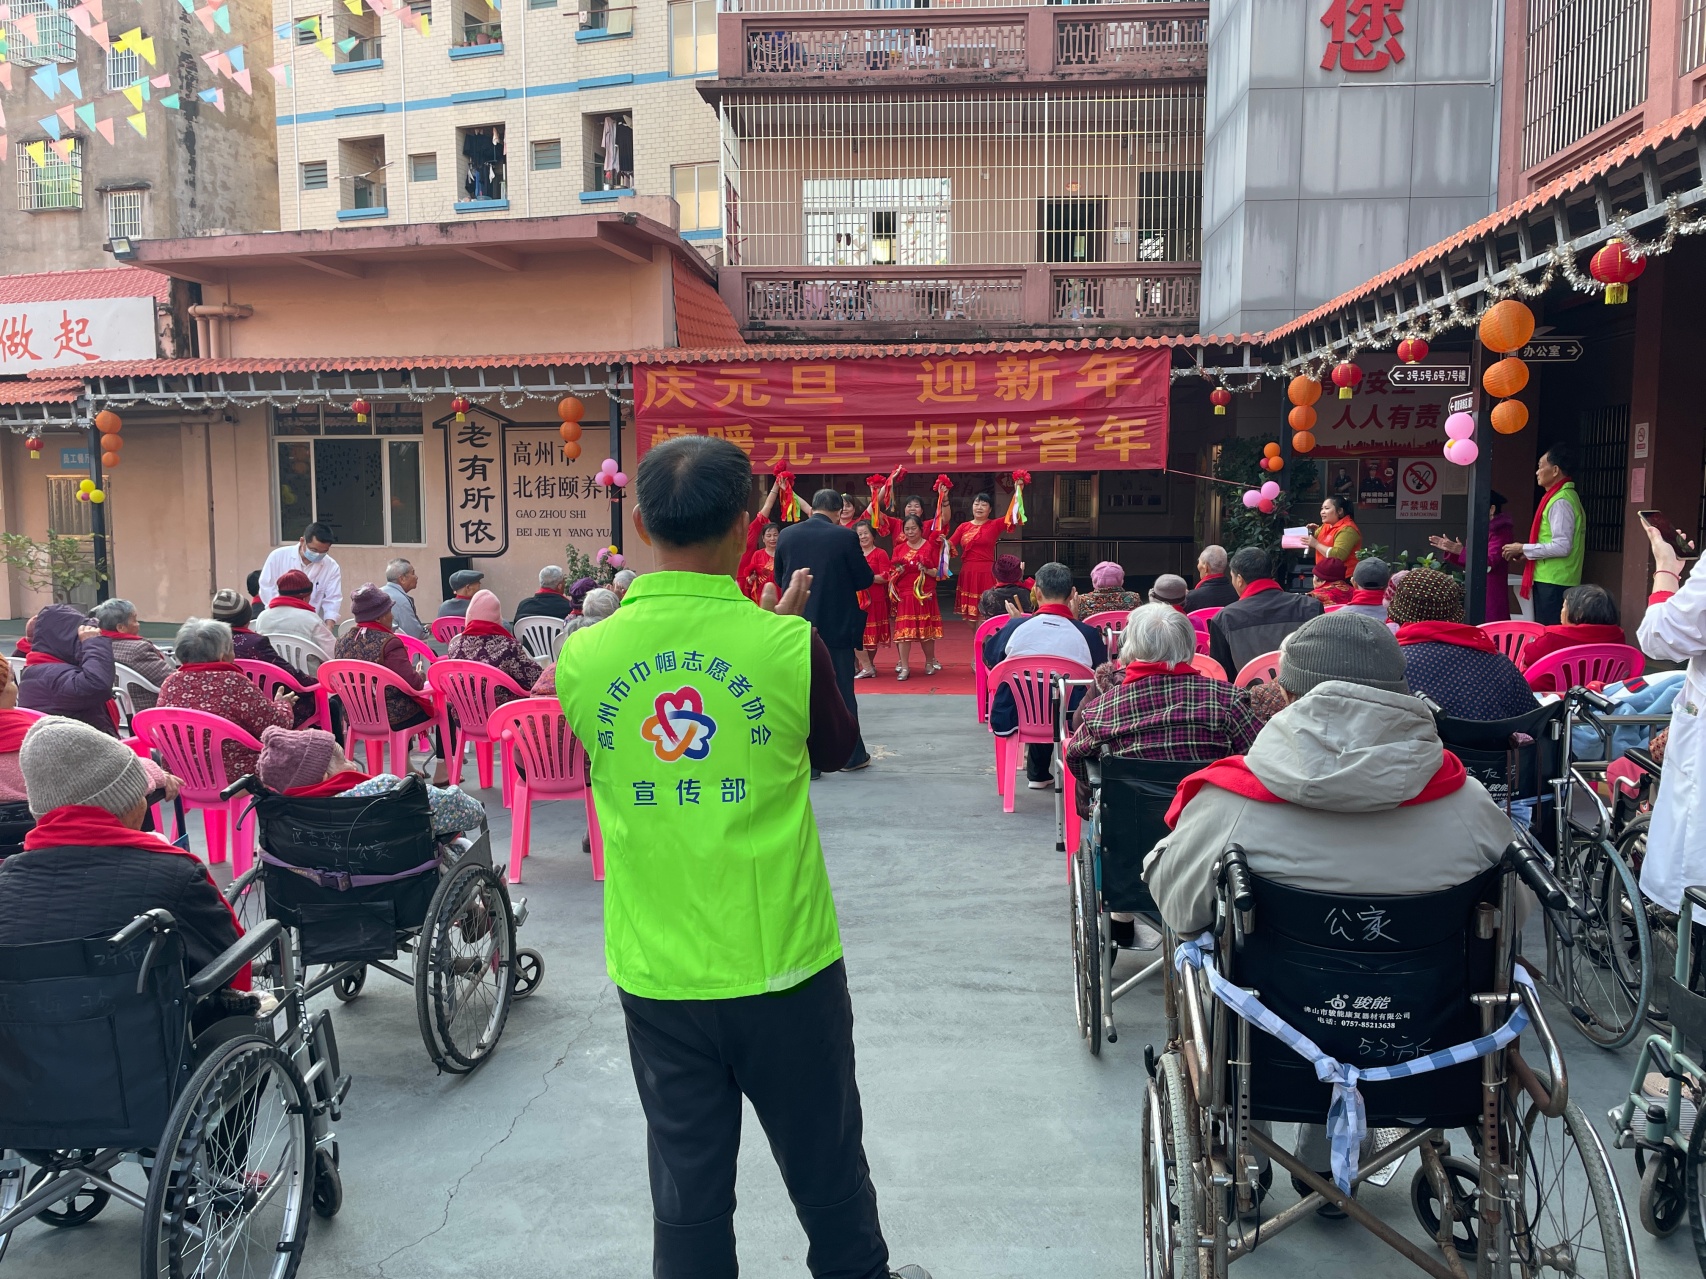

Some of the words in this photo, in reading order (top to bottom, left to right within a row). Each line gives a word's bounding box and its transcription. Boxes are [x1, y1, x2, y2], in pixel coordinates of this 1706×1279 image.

[1320, 0, 1406, 72] 您
[0, 309, 101, 362] 做起
[1523, 345, 1560, 357] 办公室
[642, 364, 844, 409] 庆元旦
[916, 354, 1142, 403] 迎新年
[1332, 404, 1441, 430] 人人有责
[651, 422, 871, 466] 暖元旦
[907, 415, 1151, 466] 相伴耆年
[457, 421, 496, 545] 老有所依
[516, 510, 537, 519] GAO
[539, 510, 567, 519] ZHOU
[569, 510, 587, 519] SHI
[1400, 500, 1439, 511] 严禁吸烟
[516, 528, 533, 537] BEI
[534, 528, 550, 537] JIE
[552, 528, 562, 537] YI
[568, 528, 593, 538] YANG
[596, 650, 772, 750] 高州市巾帼志愿者协会
[632, 777, 747, 806] 宣传部
[1324, 905, 1400, 943] 公家
[1352, 995, 1392, 1010] 骏能
